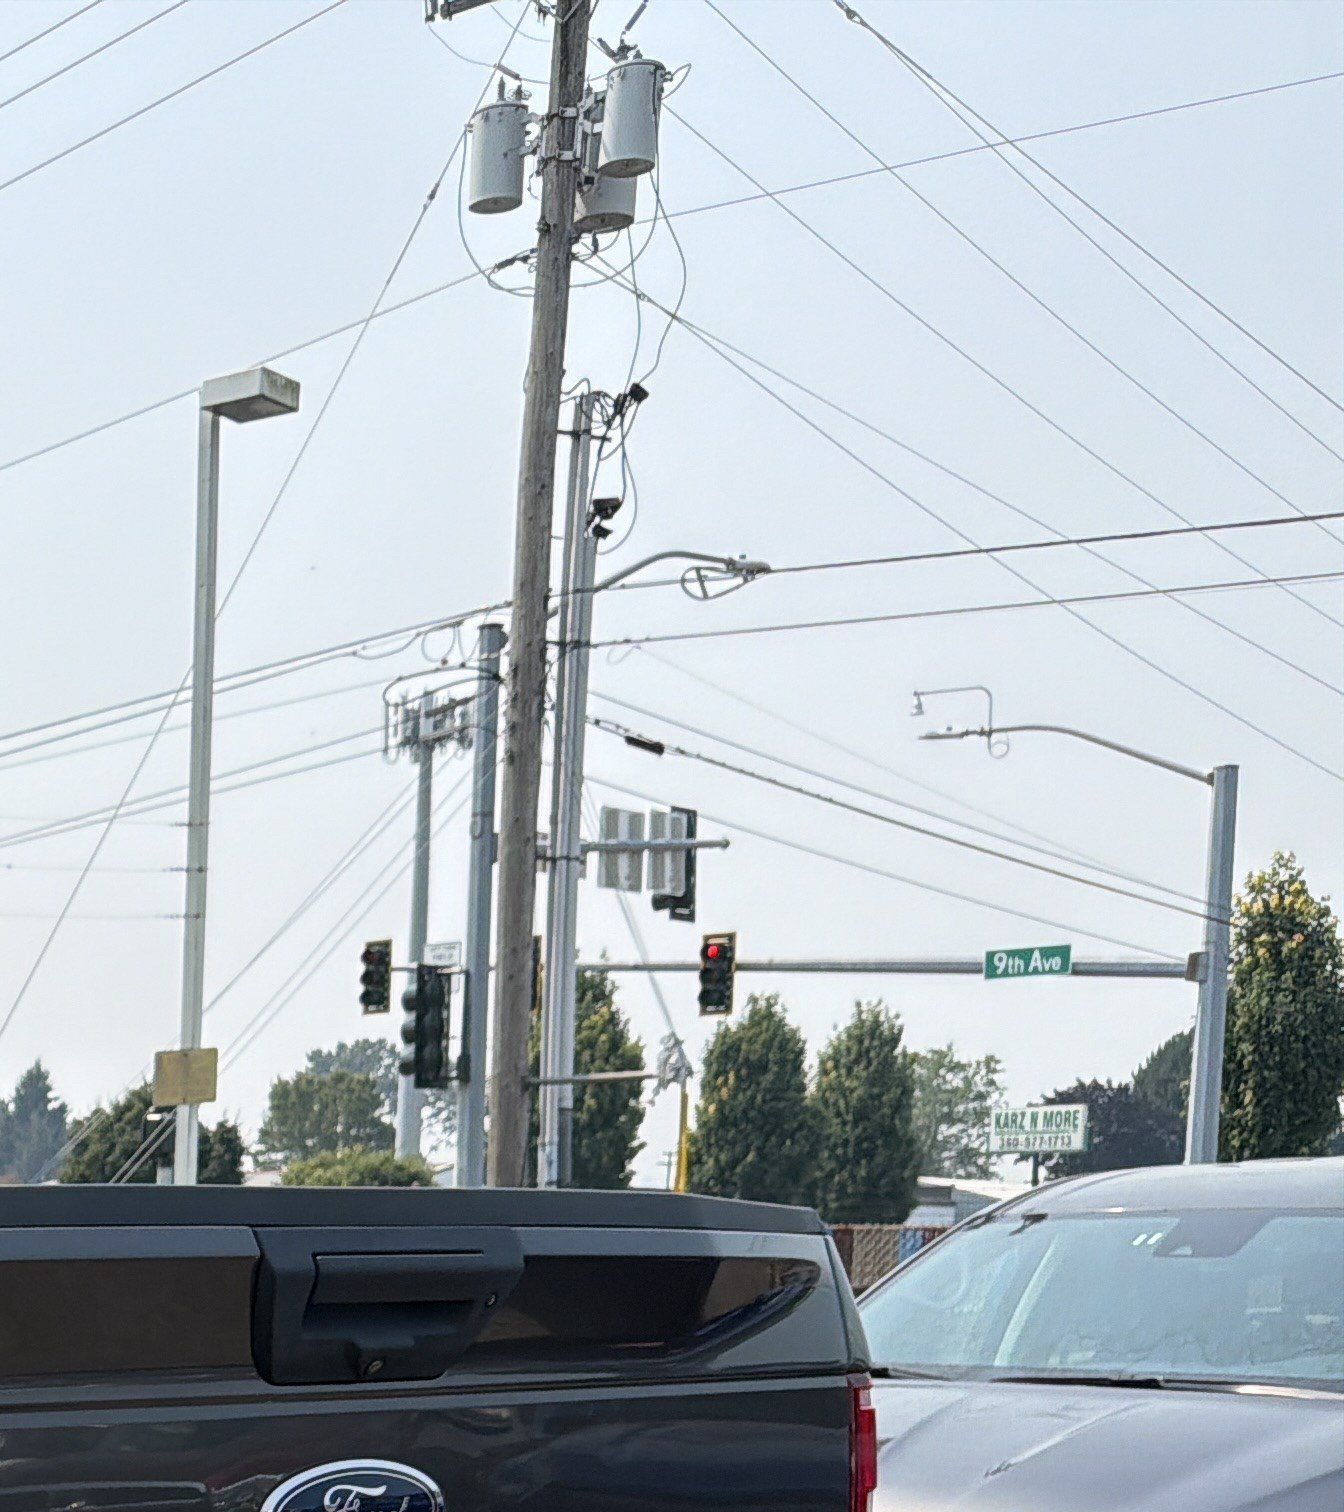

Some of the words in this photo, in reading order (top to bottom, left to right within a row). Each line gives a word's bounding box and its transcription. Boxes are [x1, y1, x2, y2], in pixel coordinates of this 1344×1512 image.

[993, 952, 1024, 975] 9th
[1028, 948, 1062, 973] Ave
[994, 1111, 1026, 1130] KARZ
[1043, 1109, 1079, 1130] MORE
